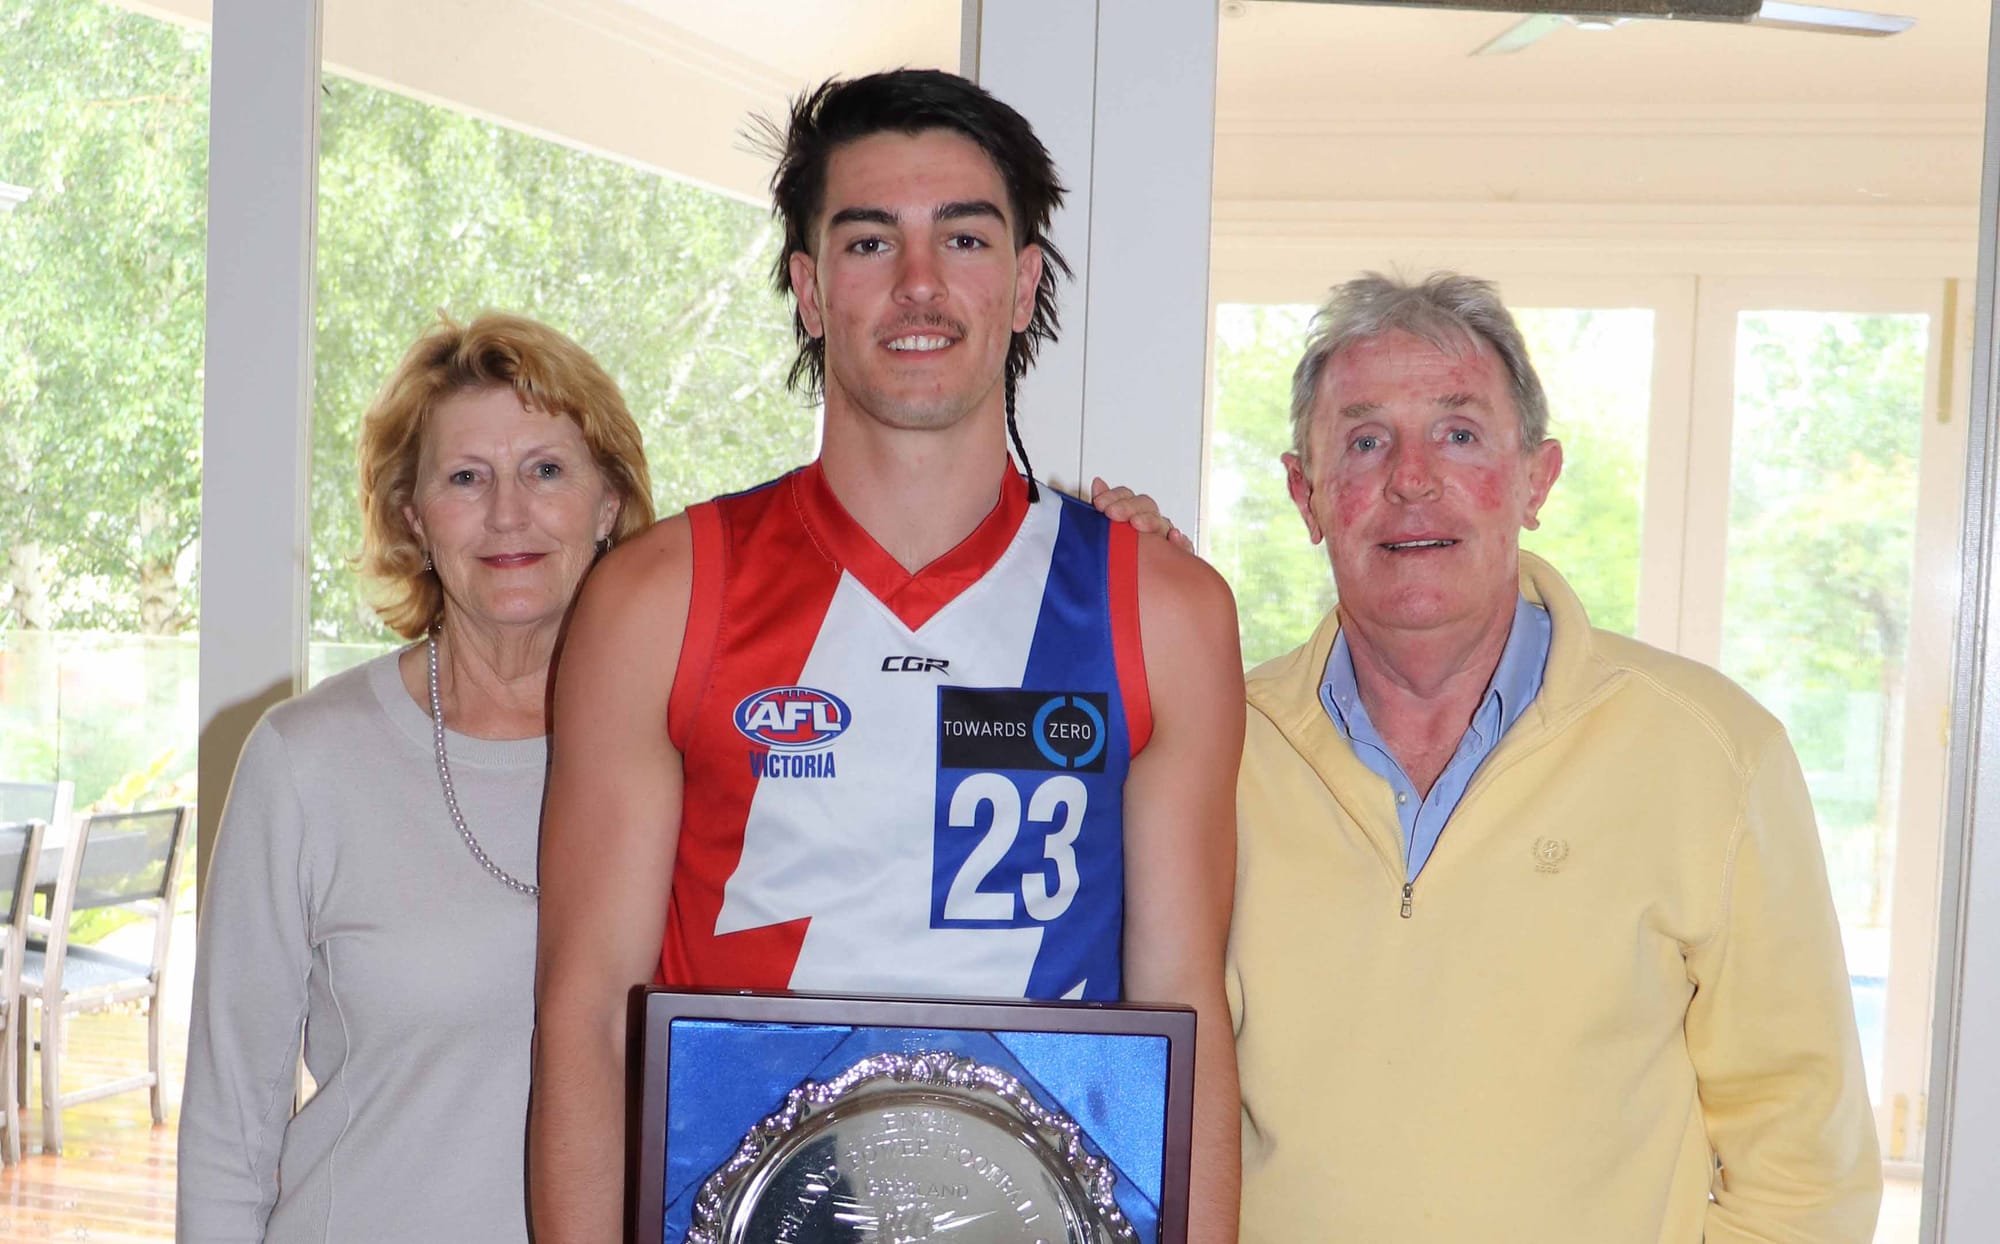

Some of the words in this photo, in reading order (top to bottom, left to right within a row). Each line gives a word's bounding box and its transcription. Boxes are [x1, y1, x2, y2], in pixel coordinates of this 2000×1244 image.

[881, 656, 949, 676] CGR
[745, 701, 841, 730] AFL
[944, 721, 1026, 737] TOWARDS
[1050, 723, 1091, 740] ZERO
[749, 751, 836, 778] VICTORIA
[943, 773, 1088, 921] 23
